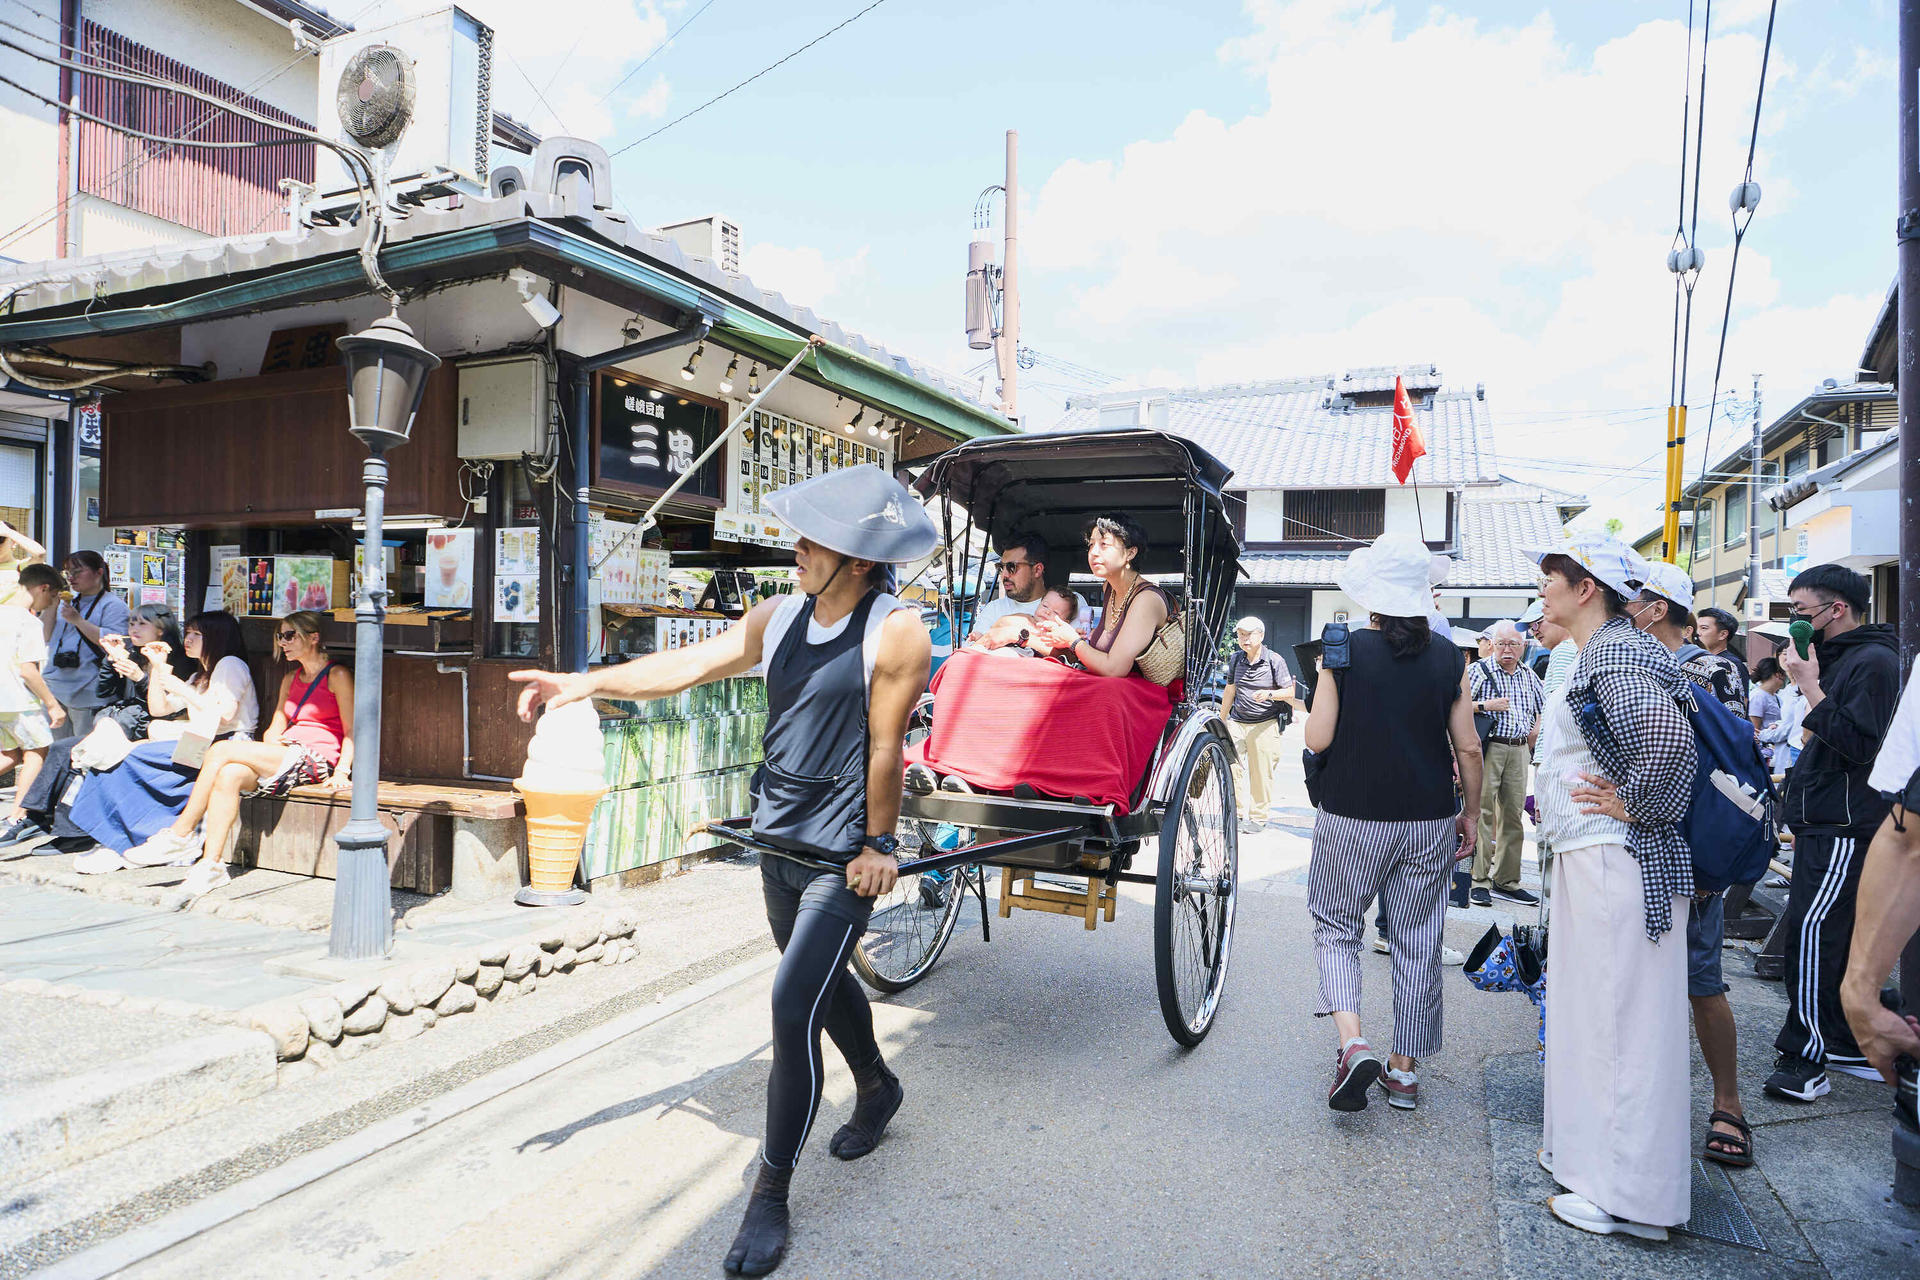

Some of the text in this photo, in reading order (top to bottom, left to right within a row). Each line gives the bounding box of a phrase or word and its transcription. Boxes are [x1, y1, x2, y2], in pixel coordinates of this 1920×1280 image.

[624, 395, 665, 420] 嵯峨豆腐
[629, 424, 695, 476] 三忠
[1392, 428, 1412, 468] RICHMOND
